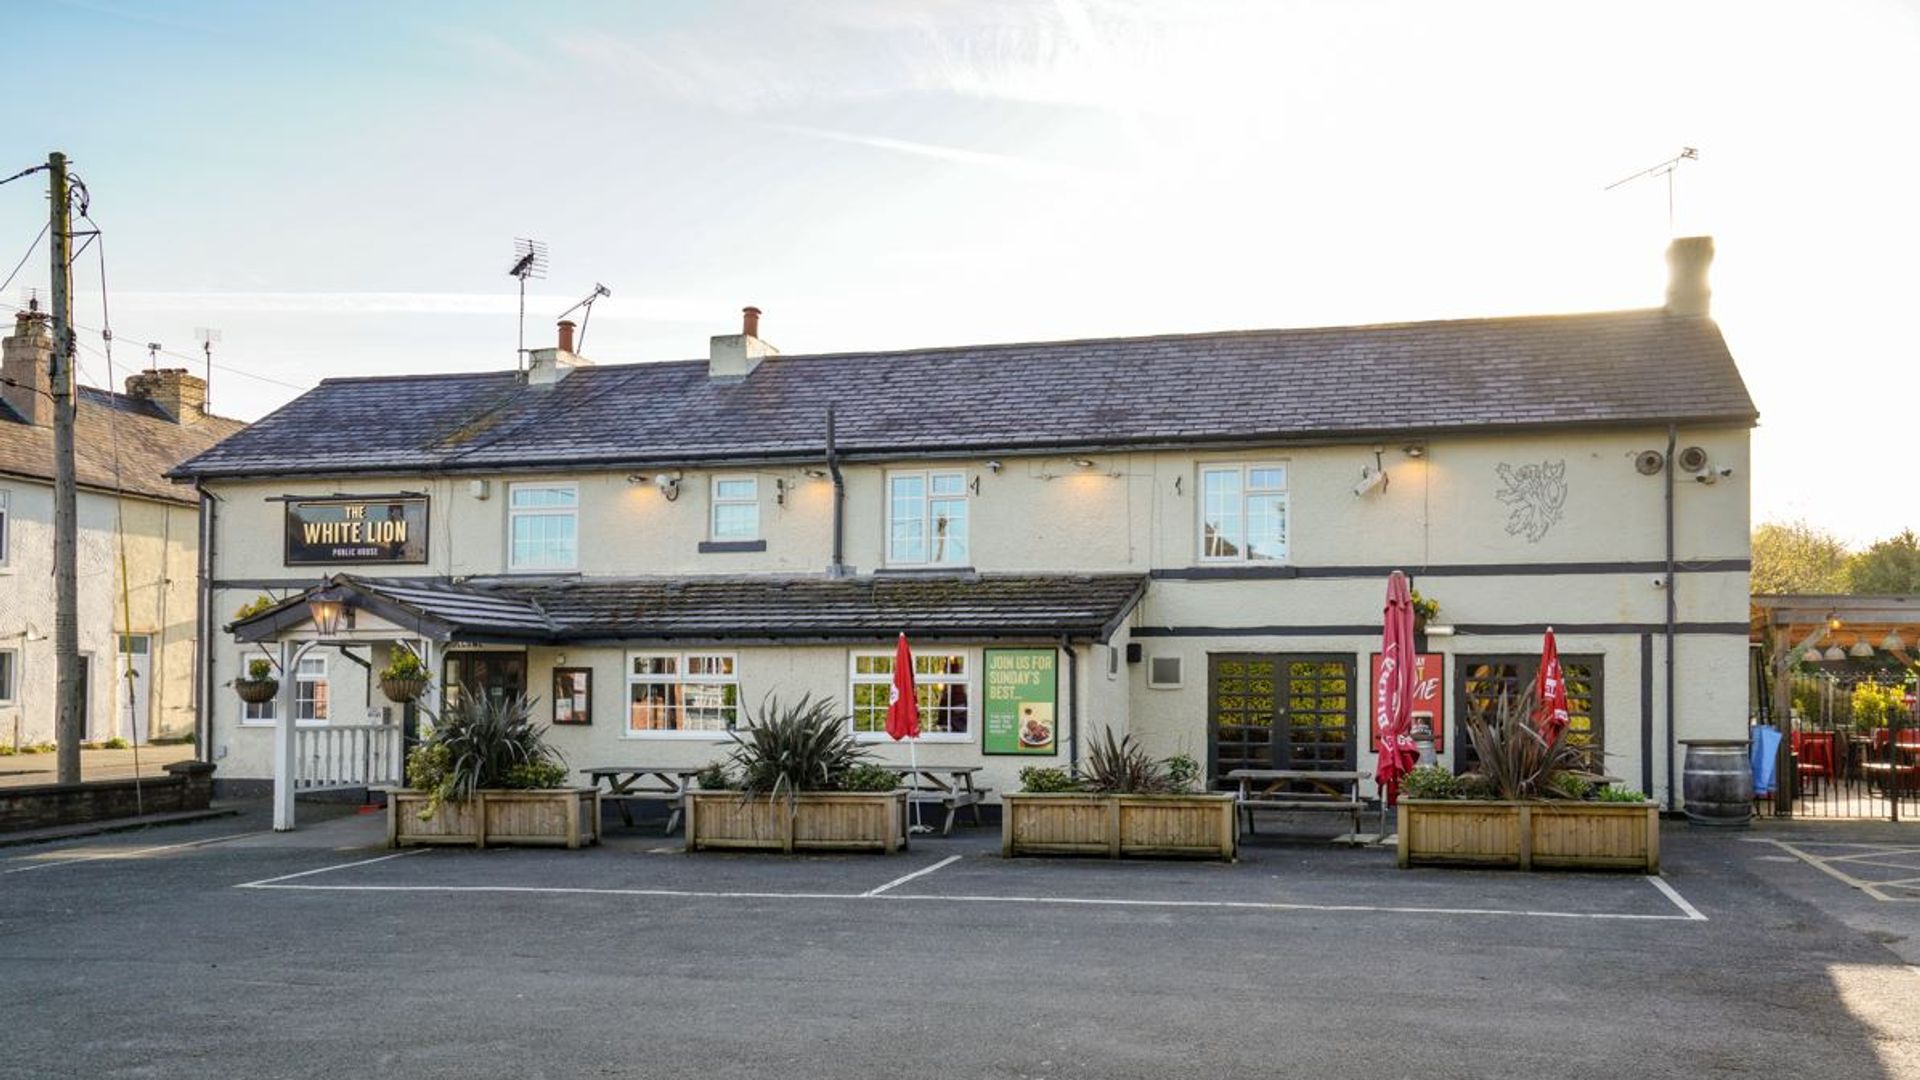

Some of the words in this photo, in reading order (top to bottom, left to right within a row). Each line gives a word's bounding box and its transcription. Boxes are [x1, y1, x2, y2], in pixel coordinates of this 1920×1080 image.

[345, 506, 364, 519] THE
[303, 523, 361, 544] WHITE
[367, 521, 407, 542] LION
[332, 548, 355, 557] PUBLIC
[357, 547, 378, 556] HOUSE
[990, 655, 1014, 670] JOIN
[1016, 655, 1030, 670] US
[1032, 655, 1053, 670] FOR
[989, 671, 1040, 685] SUNDAY'S
